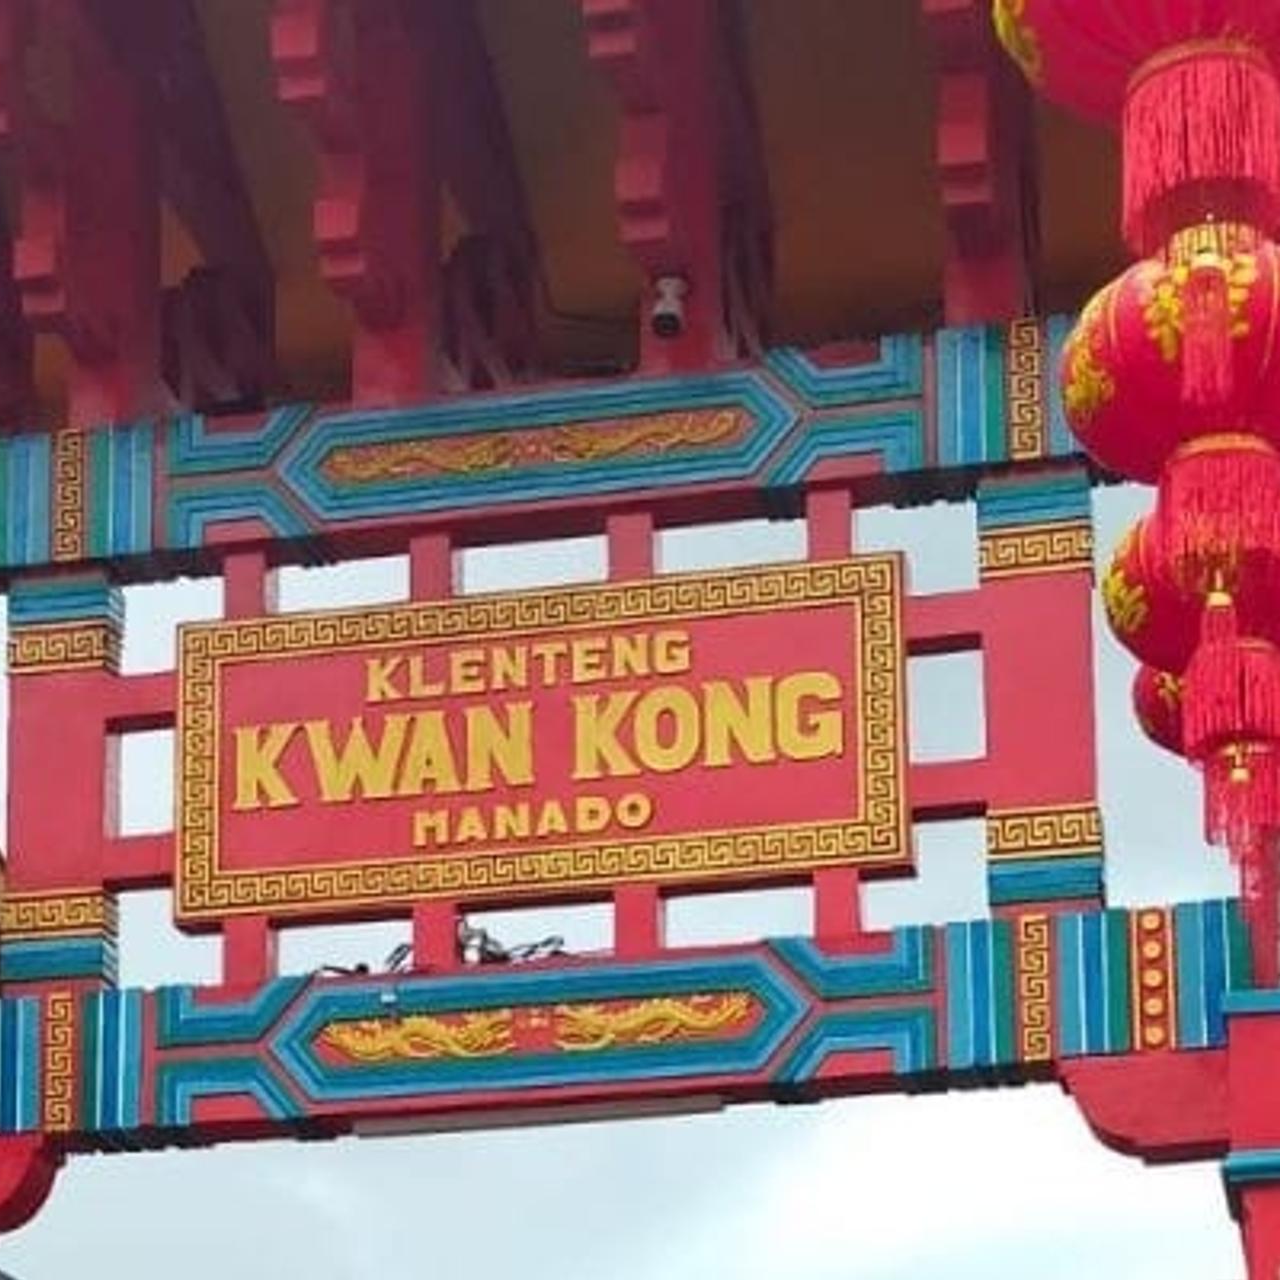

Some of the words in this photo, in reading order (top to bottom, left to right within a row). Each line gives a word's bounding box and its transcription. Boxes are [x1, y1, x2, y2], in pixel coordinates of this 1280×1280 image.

[365, 629, 692, 702] KLENTENG
[232, 700, 535, 812] KWAN
[571, 671, 845, 781] KONG
[412, 791, 655, 847] MANADO
